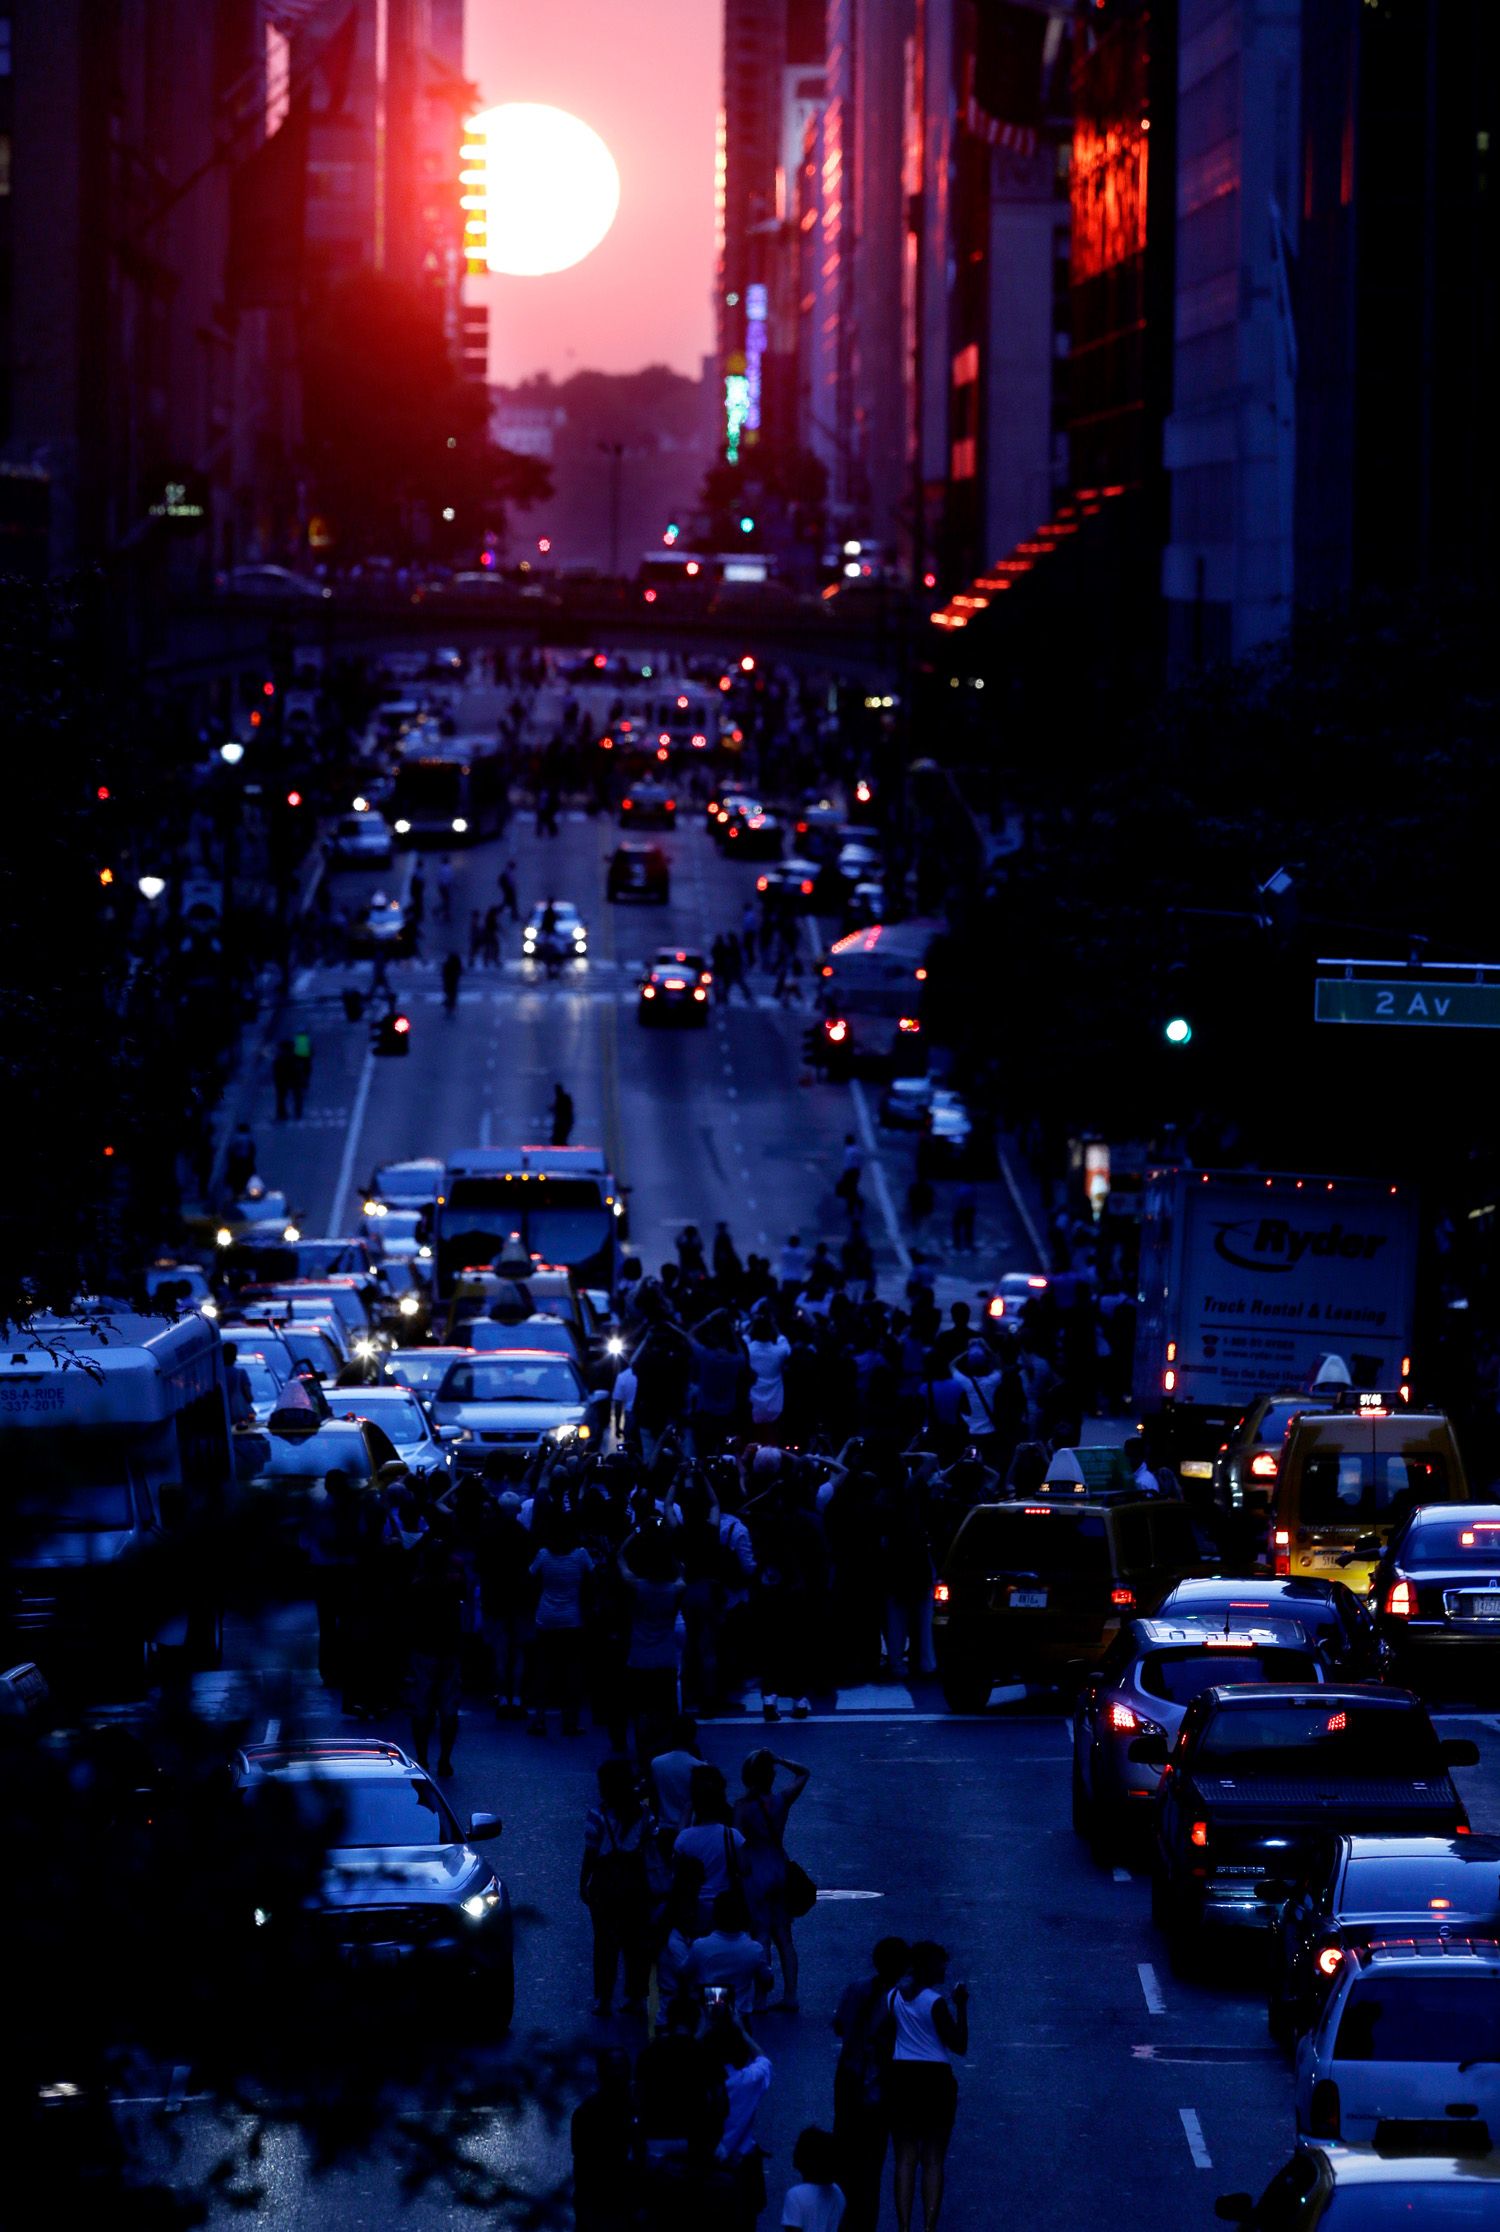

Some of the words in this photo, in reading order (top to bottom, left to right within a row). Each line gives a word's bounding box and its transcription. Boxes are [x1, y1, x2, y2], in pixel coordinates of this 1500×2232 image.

[1375, 991, 1395, 1015] 2
[1407, 992, 1451, 1016] Av
[1254, 1218, 1388, 1262] Ryder
[1204, 1296, 1245, 1314] Truck
[1251, 1299, 1304, 1317] Rental
[1308, 1303, 1320, 1319] &
[1325, 1303, 1387, 1326] Leasing
